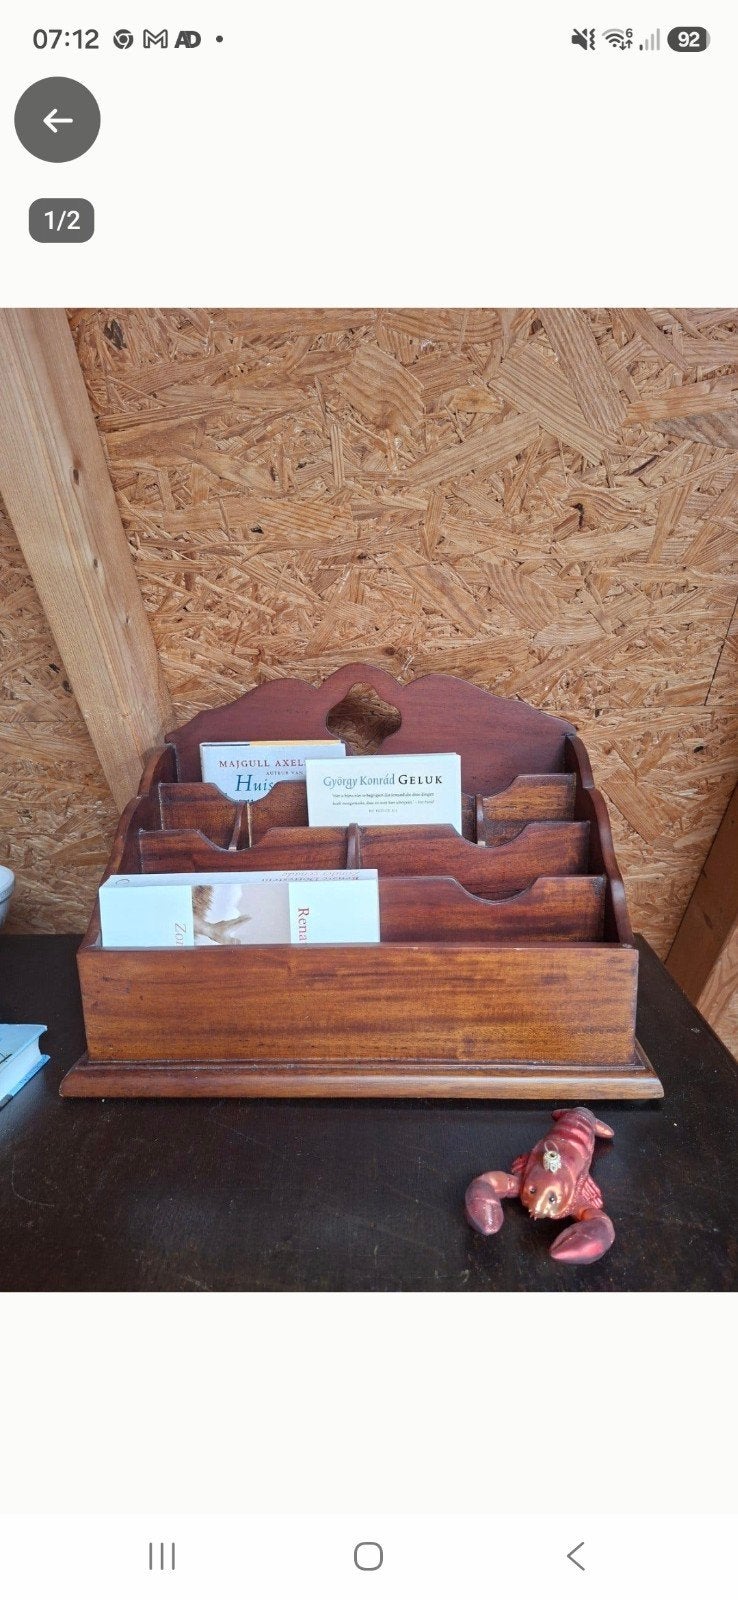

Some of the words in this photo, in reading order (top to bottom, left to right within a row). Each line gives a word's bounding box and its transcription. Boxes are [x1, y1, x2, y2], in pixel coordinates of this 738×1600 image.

[219, 759, 270, 770] MAJGULL
[275, 759, 306, 767] AXEL
[323, 776, 358, 790] György
[360, 773, 395, 786] Konrád
[297, 907, 310, 944] Rena
